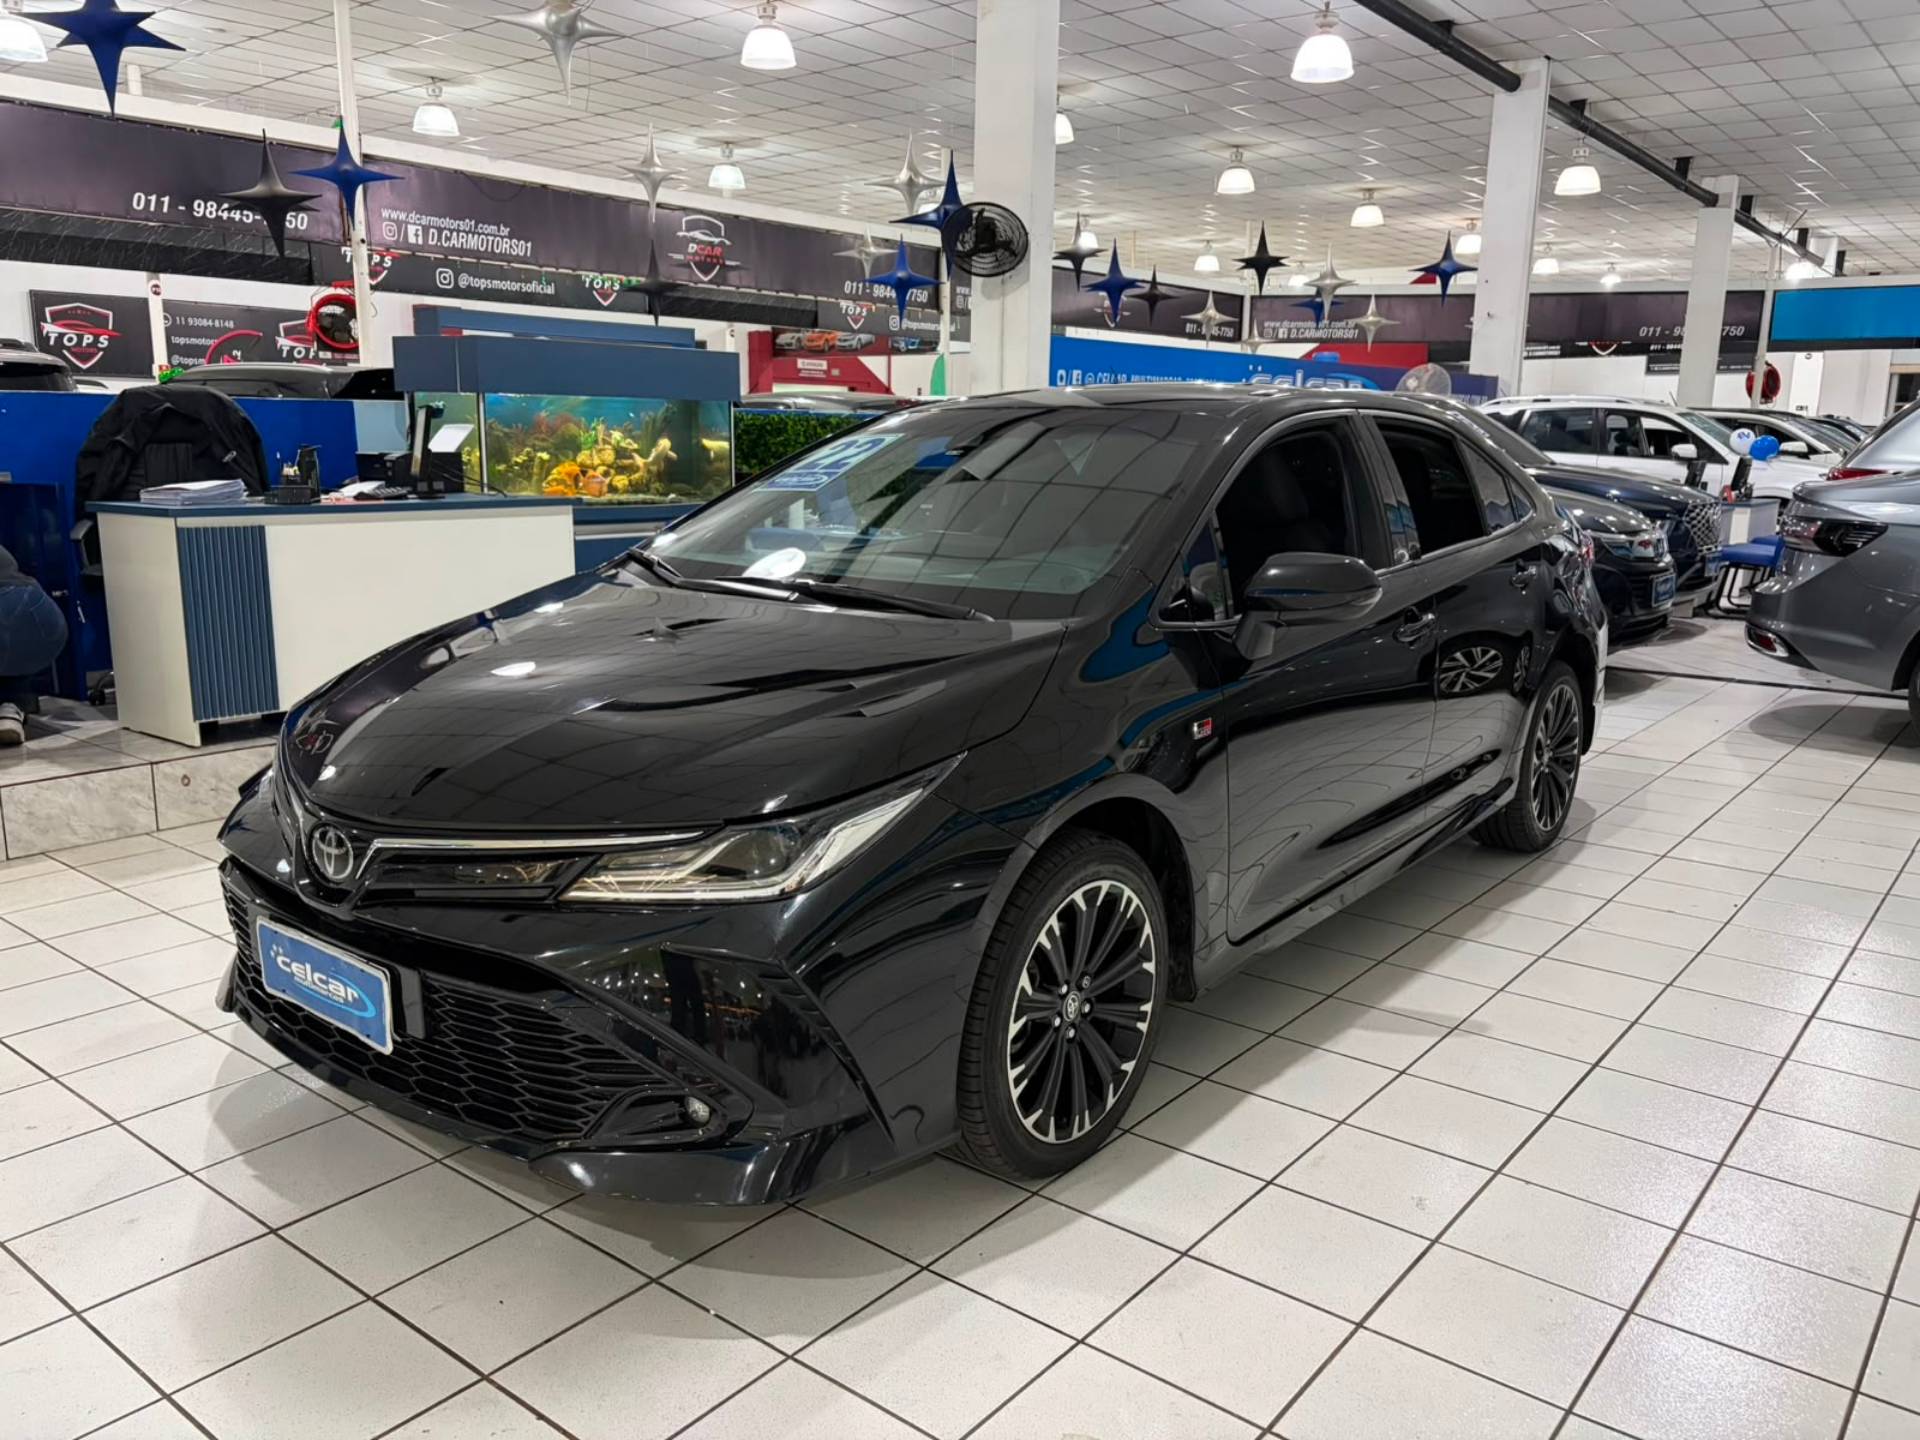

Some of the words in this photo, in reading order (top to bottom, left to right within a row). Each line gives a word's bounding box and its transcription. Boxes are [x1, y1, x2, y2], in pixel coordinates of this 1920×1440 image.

[132, 192, 170, 213] 011
[193, 199, 308, 230] 98445-50
[381, 208, 510, 236] www.dcarmotors01.com.br
[428, 228, 532, 257] D.CARMOTORS01
[345, 251, 392, 268] TPS
[458, 273, 555, 295] @topsmotorsoficial
[844, 281, 863, 295] 011
[841, 303, 868, 317] TOPS
[48, 333, 109, 348] TOPS
[1639, 326, 1661, 337] 011
[276, 955, 359, 1002] celcar
